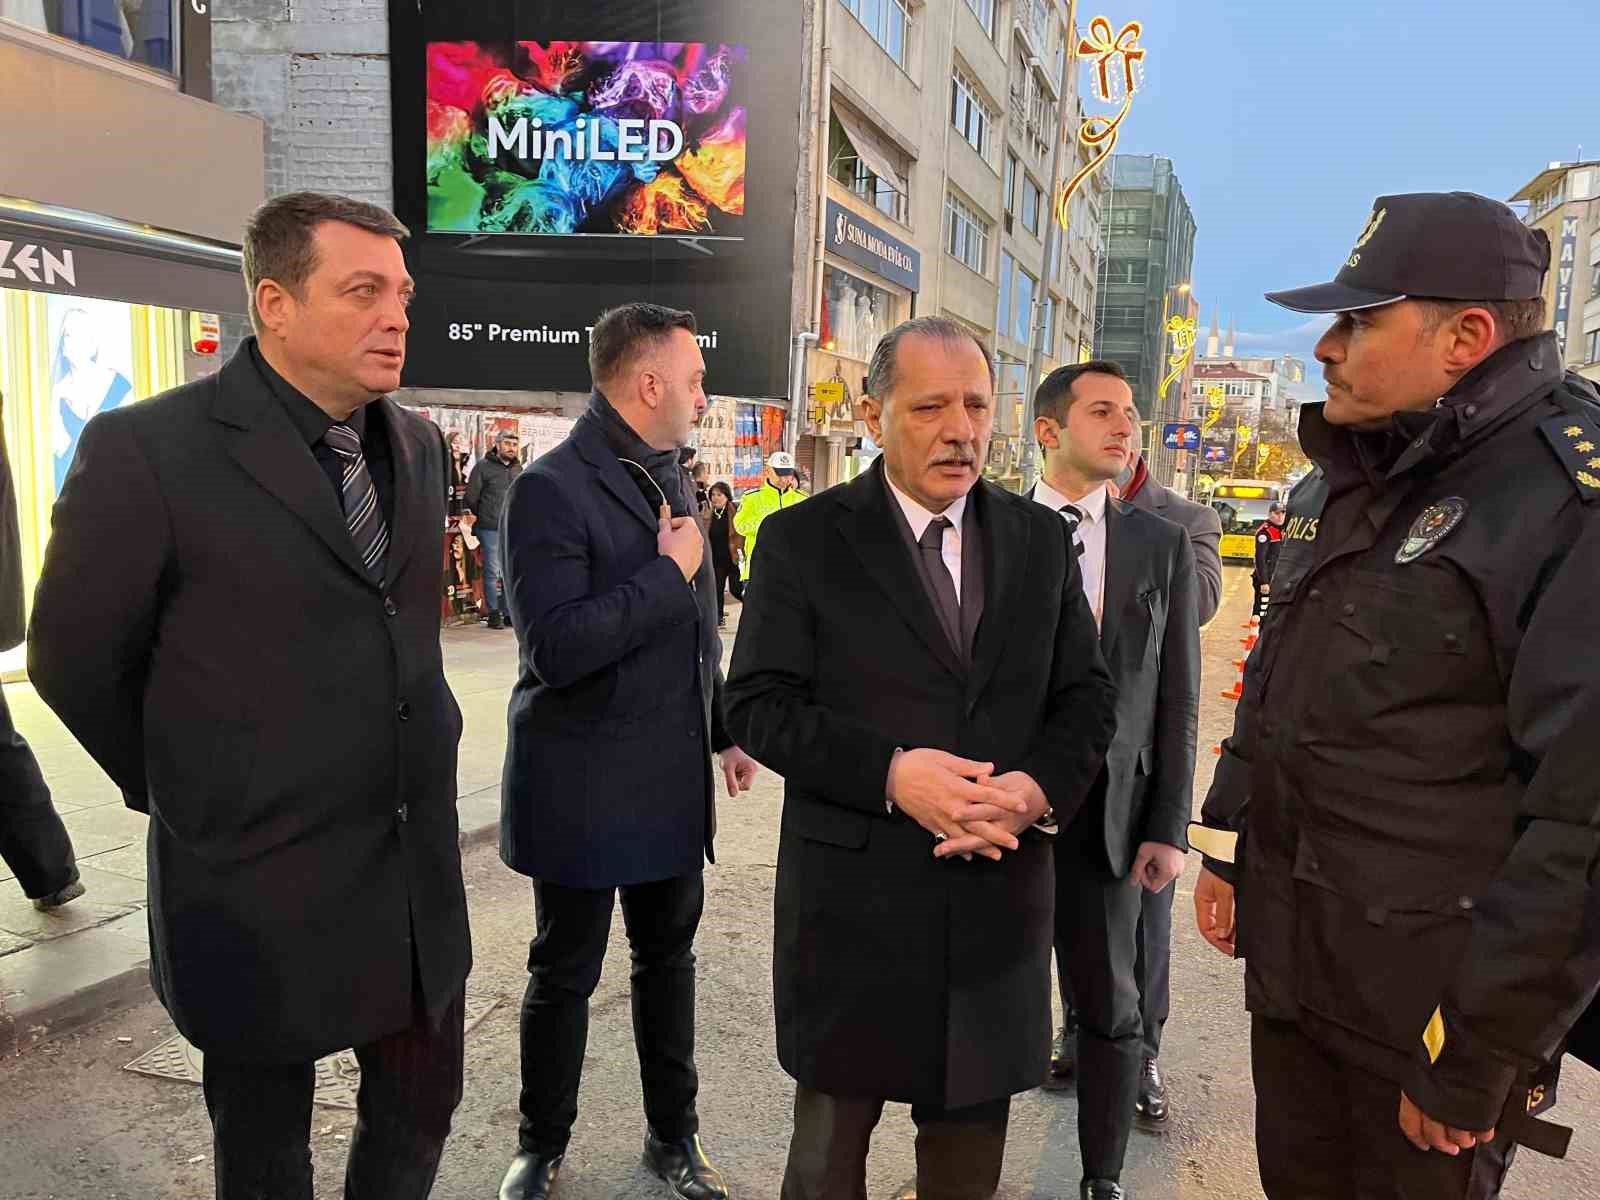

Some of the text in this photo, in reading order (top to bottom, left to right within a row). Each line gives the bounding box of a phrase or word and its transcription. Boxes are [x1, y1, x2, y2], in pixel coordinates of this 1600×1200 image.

[487, 116, 685, 161] MiniLED
[448, 323, 482, 341] 85"
[488, 323, 580, 344] Premium
